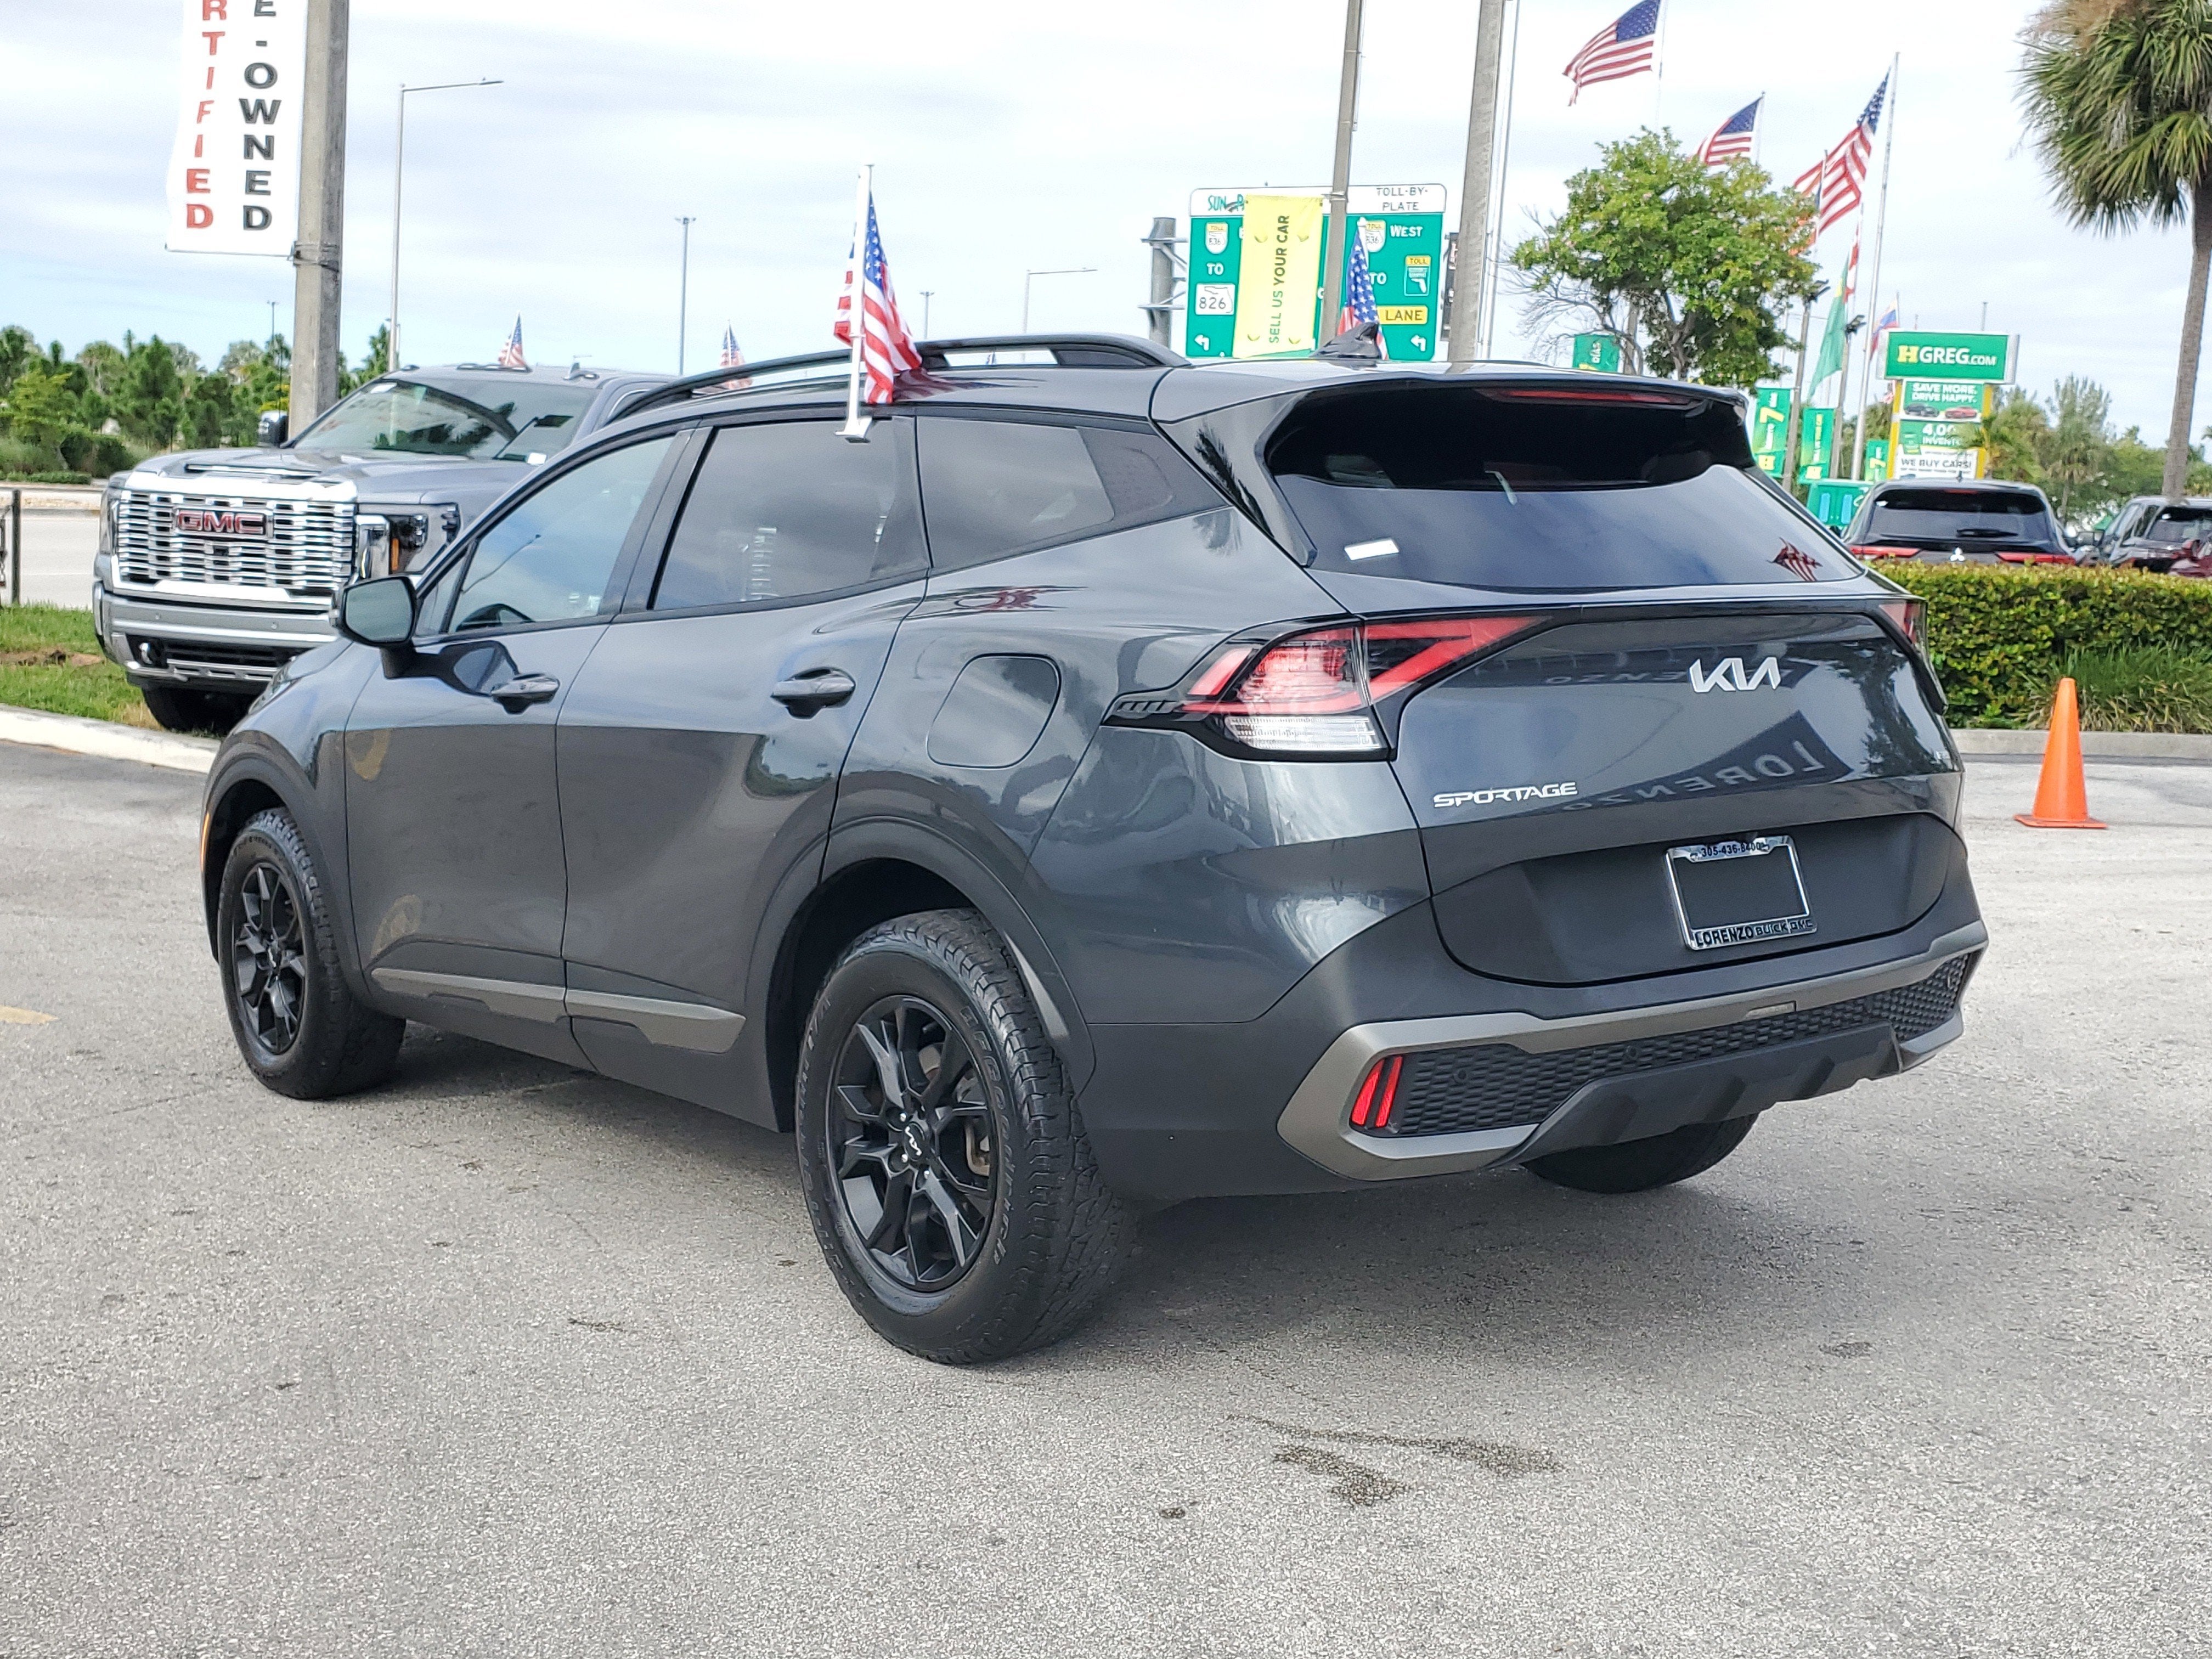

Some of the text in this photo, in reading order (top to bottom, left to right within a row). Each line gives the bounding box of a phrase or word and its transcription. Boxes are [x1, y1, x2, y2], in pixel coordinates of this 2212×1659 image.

[1382, 202, 1419, 211] PLATE
[1390, 224, 1423, 237] WEST
[1206, 262, 1224, 275] TO
[1269, 215, 1290, 343] SELL US YOUR CAR
[1370, 272, 1387, 285] TO
[1199, 297, 1227, 309] 826
[1385, 309, 1423, 321] LANE
[1912, 382, 1941, 392] SAVE
[1912, 391, 1940, 402] DRIVE
[1759, 407, 1785, 423] 7
[1901, 458, 1916, 466] WE
[1919, 459, 1940, 467] BUY
[178, 510, 264, 534] GMC
[1689, 657, 1781, 692] KIA
[1433, 782, 1578, 808] SPORTAGE
[1694, 926, 1754, 947] LORENZO
[1756, 922, 1787, 936] BUICK
